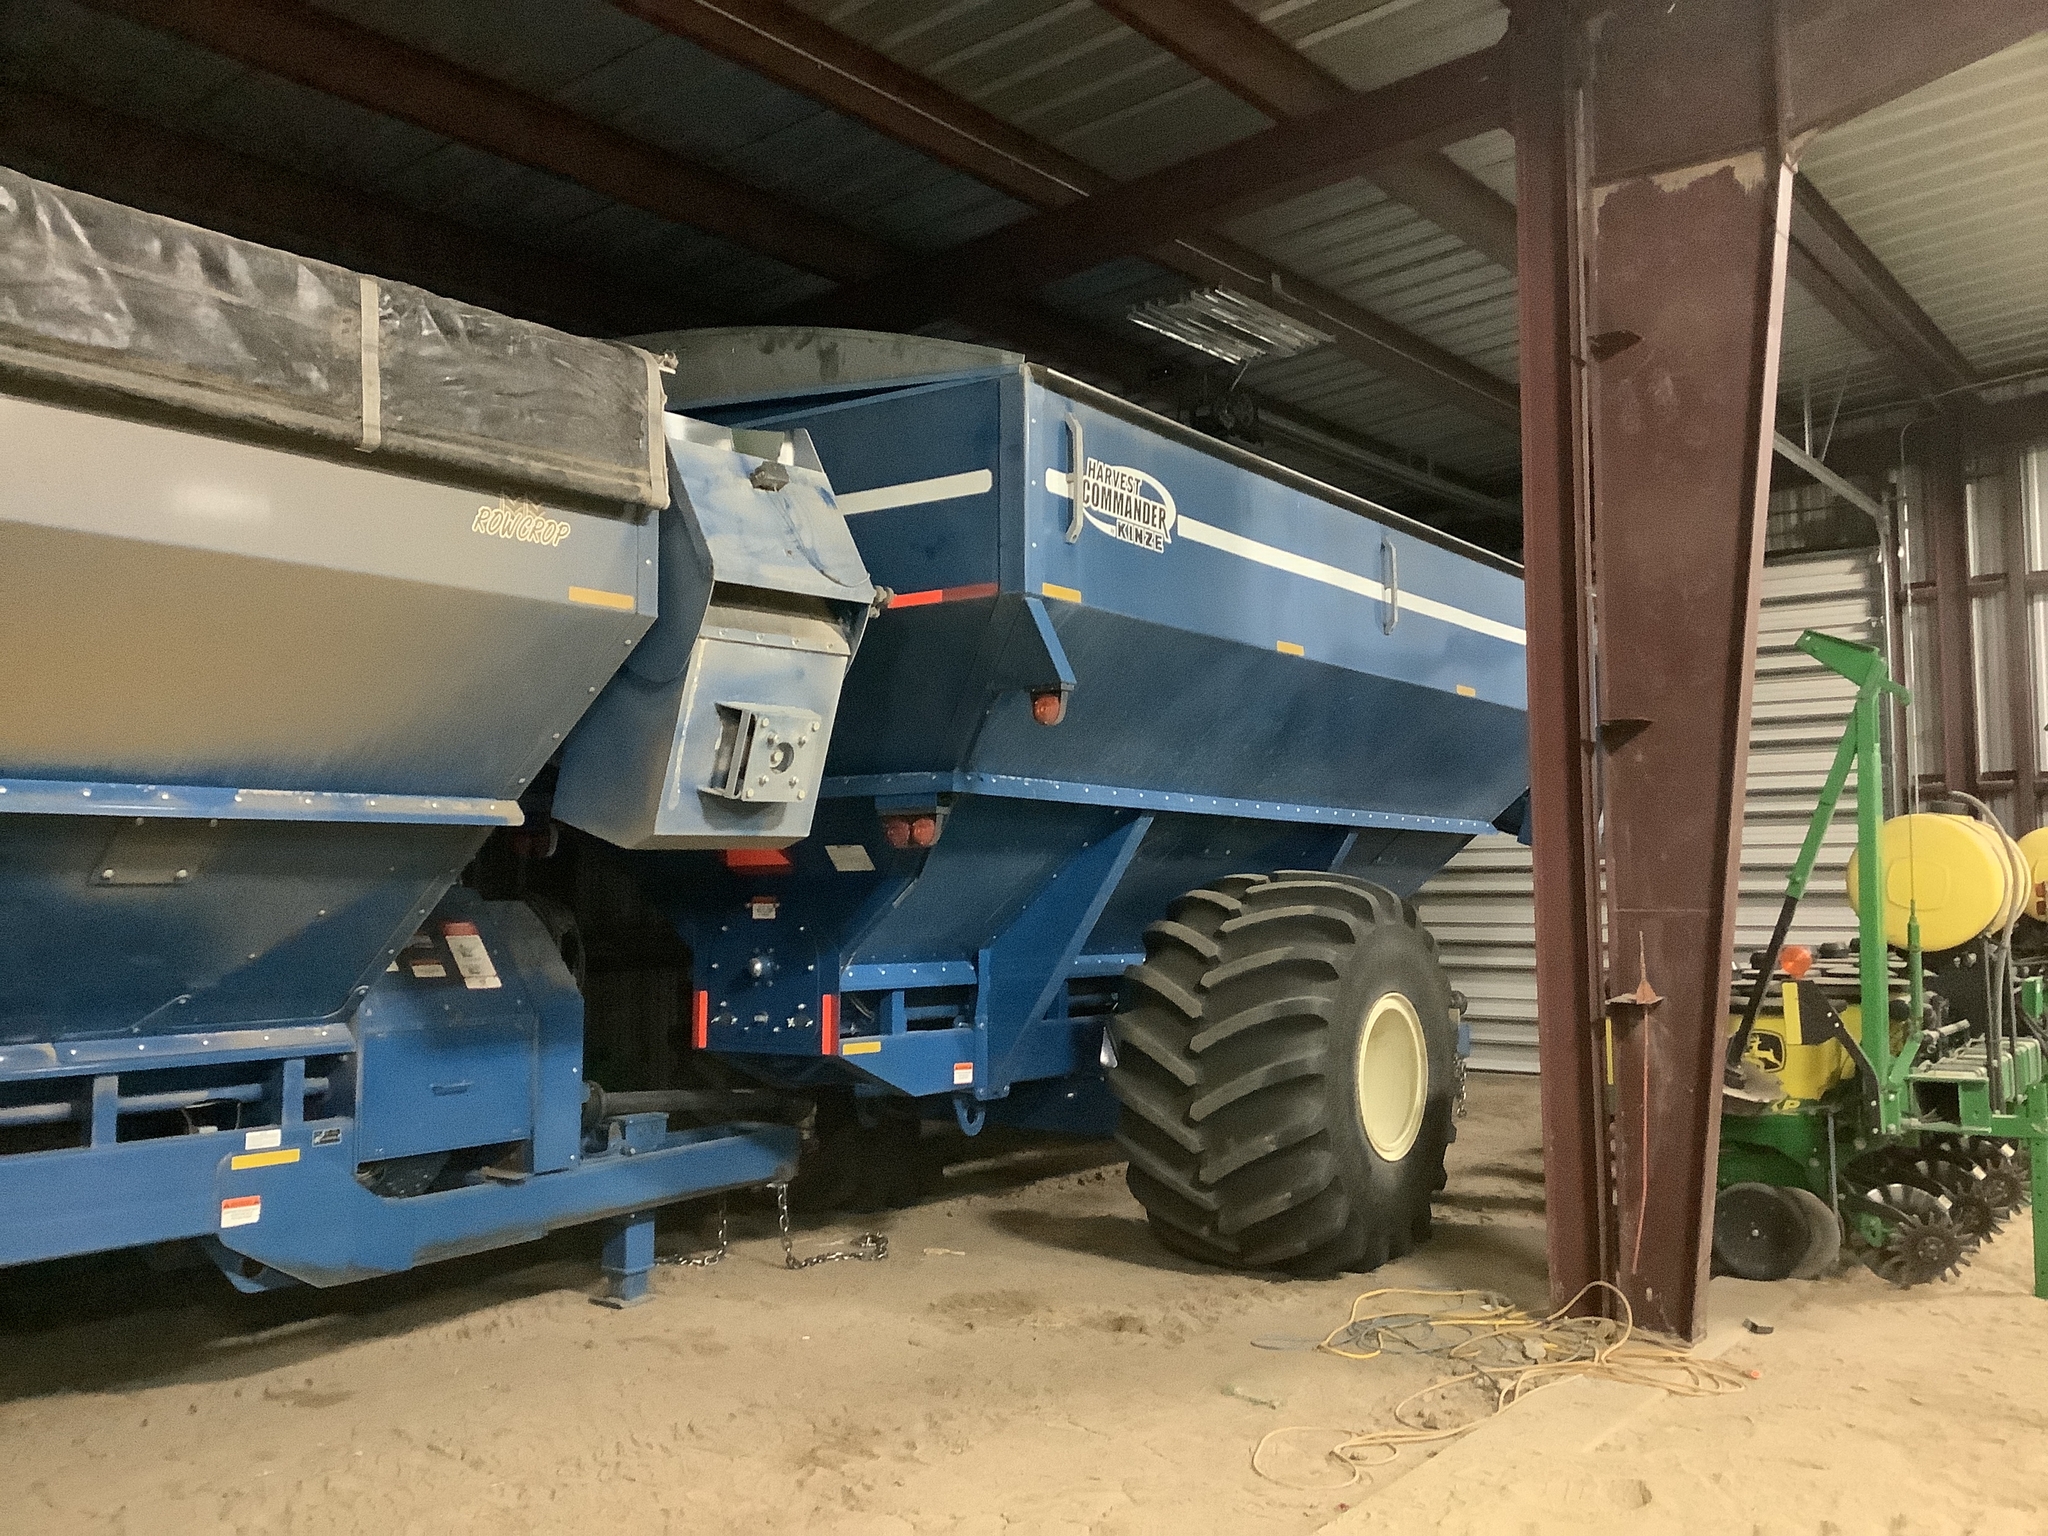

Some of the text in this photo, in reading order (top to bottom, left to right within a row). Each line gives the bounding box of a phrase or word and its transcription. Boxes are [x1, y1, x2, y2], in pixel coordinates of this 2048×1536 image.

[1088, 460, 1141, 496] HARVEST
[472, 506, 571, 546] ROWCROP
[1083, 479, 1169, 539] COMMANDER
[1118, 521, 1163, 551] KINZE
